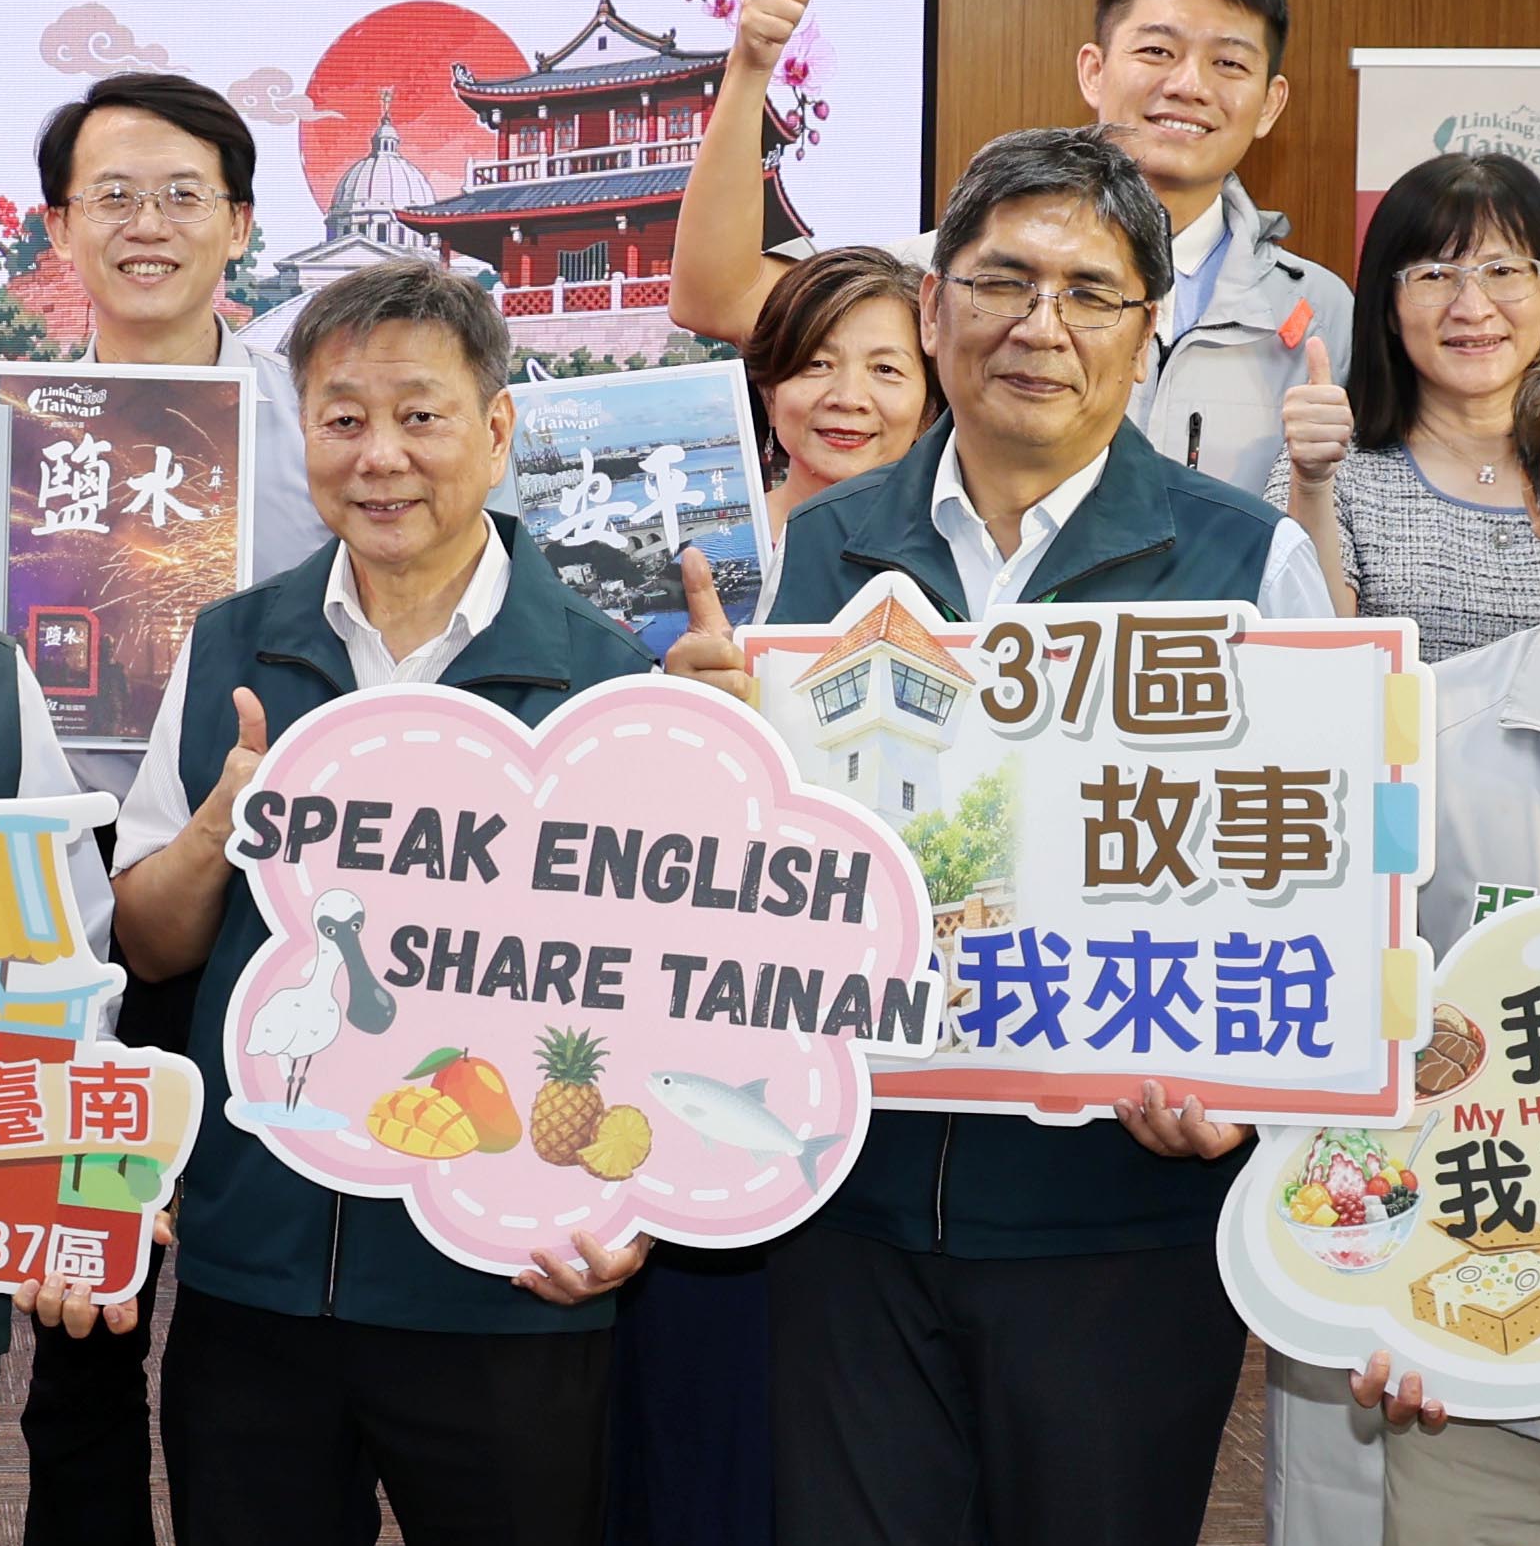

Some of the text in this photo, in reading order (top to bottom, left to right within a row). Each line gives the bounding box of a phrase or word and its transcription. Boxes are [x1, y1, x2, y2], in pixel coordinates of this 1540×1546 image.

[1460, 113, 1534, 139] Linking
[40, 399, 103, 417] Taiwan
[42, 386, 82, 402] Linking
[536, 416, 600, 431] Taiwan
[31, 433, 205, 535] 鹽水
[547, 445, 706, 556] 安平
[980, 613, 1230, 736] 37區
[236, 790, 871, 925] SPEAK ENGLISH
[1081, 764, 1333, 891] 故事
[384, 924, 931, 1046] SHARE TAINAN
[928, 927, 1335, 1057] 我來說
[1453, 1104, 1502, 1138] My
